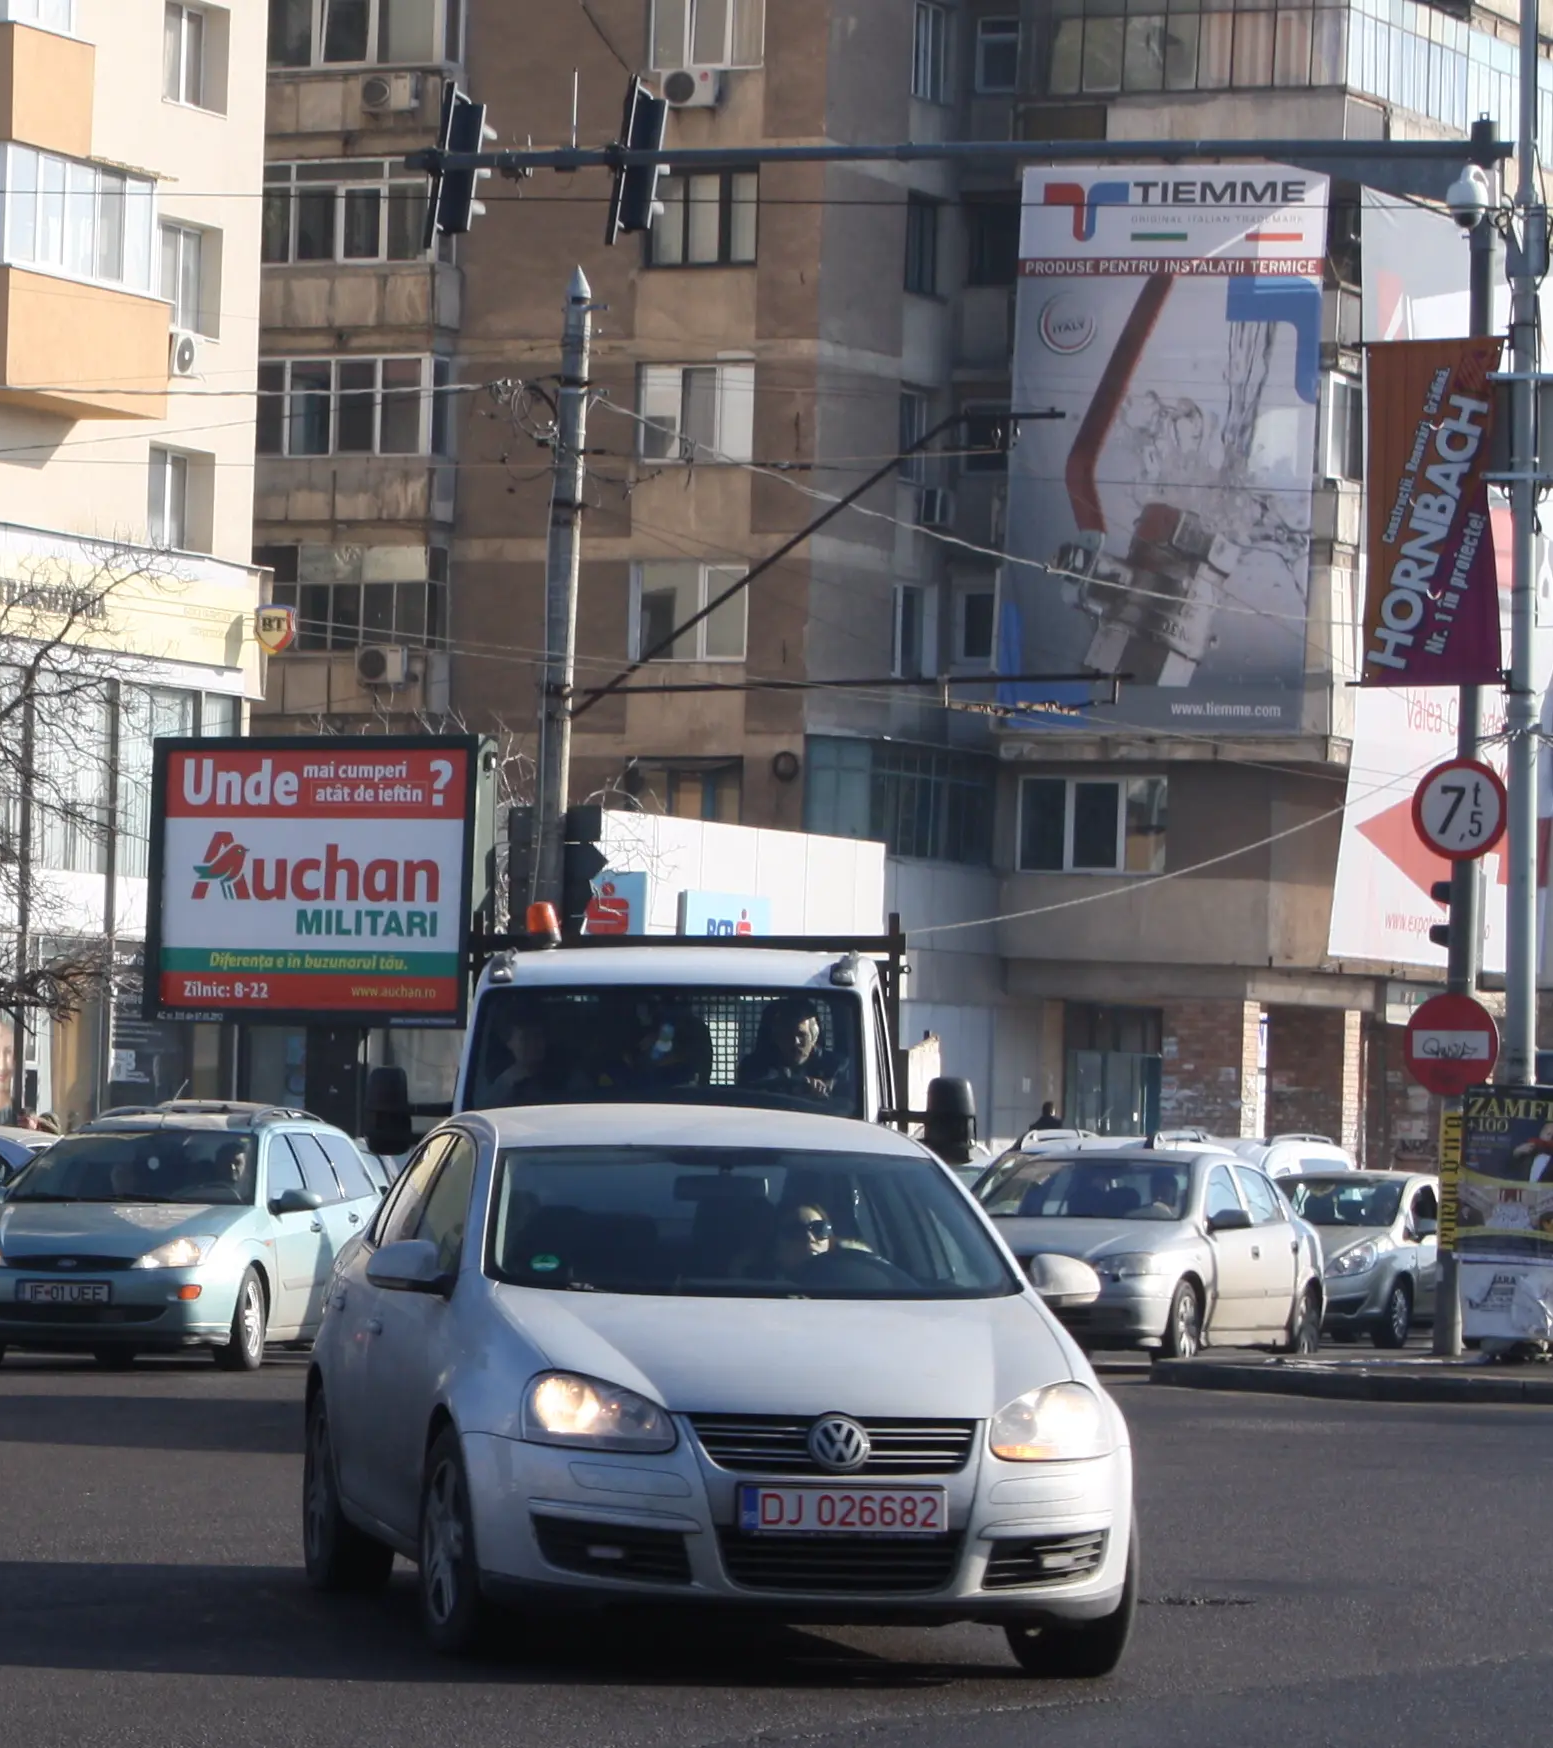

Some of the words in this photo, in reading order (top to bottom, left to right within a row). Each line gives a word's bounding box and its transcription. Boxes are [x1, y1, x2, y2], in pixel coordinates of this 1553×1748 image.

[1133, 180, 1306, 204] TIEMME
[1188, 214, 1230, 225] ITALIAN
[1025, 260, 1095, 275] PRODUSE
[1099, 260, 1160, 275] PENTRU
[1164, 260, 1245, 275] INSTALATII
[1250, 259, 1317, 274] TERMICE
[1366, 393, 1489, 670] HORNBACH
[1450, 512, 1487, 589] proiecte!
[261, 616, 288, 632] BT
[1170, 701, 1282, 717] www.tiemme.com
[1405, 687, 1443, 733] Valea
[183, 758, 299, 806] Unde
[303, 761, 336, 779] mai
[338, 761, 408, 783] cumperi
[315, 783, 351, 803] atât
[353, 784, 375, 803] de
[191, 831, 440, 903] Auchan
[295, 908, 438, 938] MILITARI
[276, 957, 283, 968] e
[287, 953, 301, 969] în
[304, 954, 377, 970] buzunarul
[183, 980, 231, 998] Zilnic:
[233, 982, 269, 999] 8-22
[350, 984, 437, 1000] www.auchan.ro
[760, 1492, 804, 1526] DJ
[817, 1494, 939, 1528] 026682
